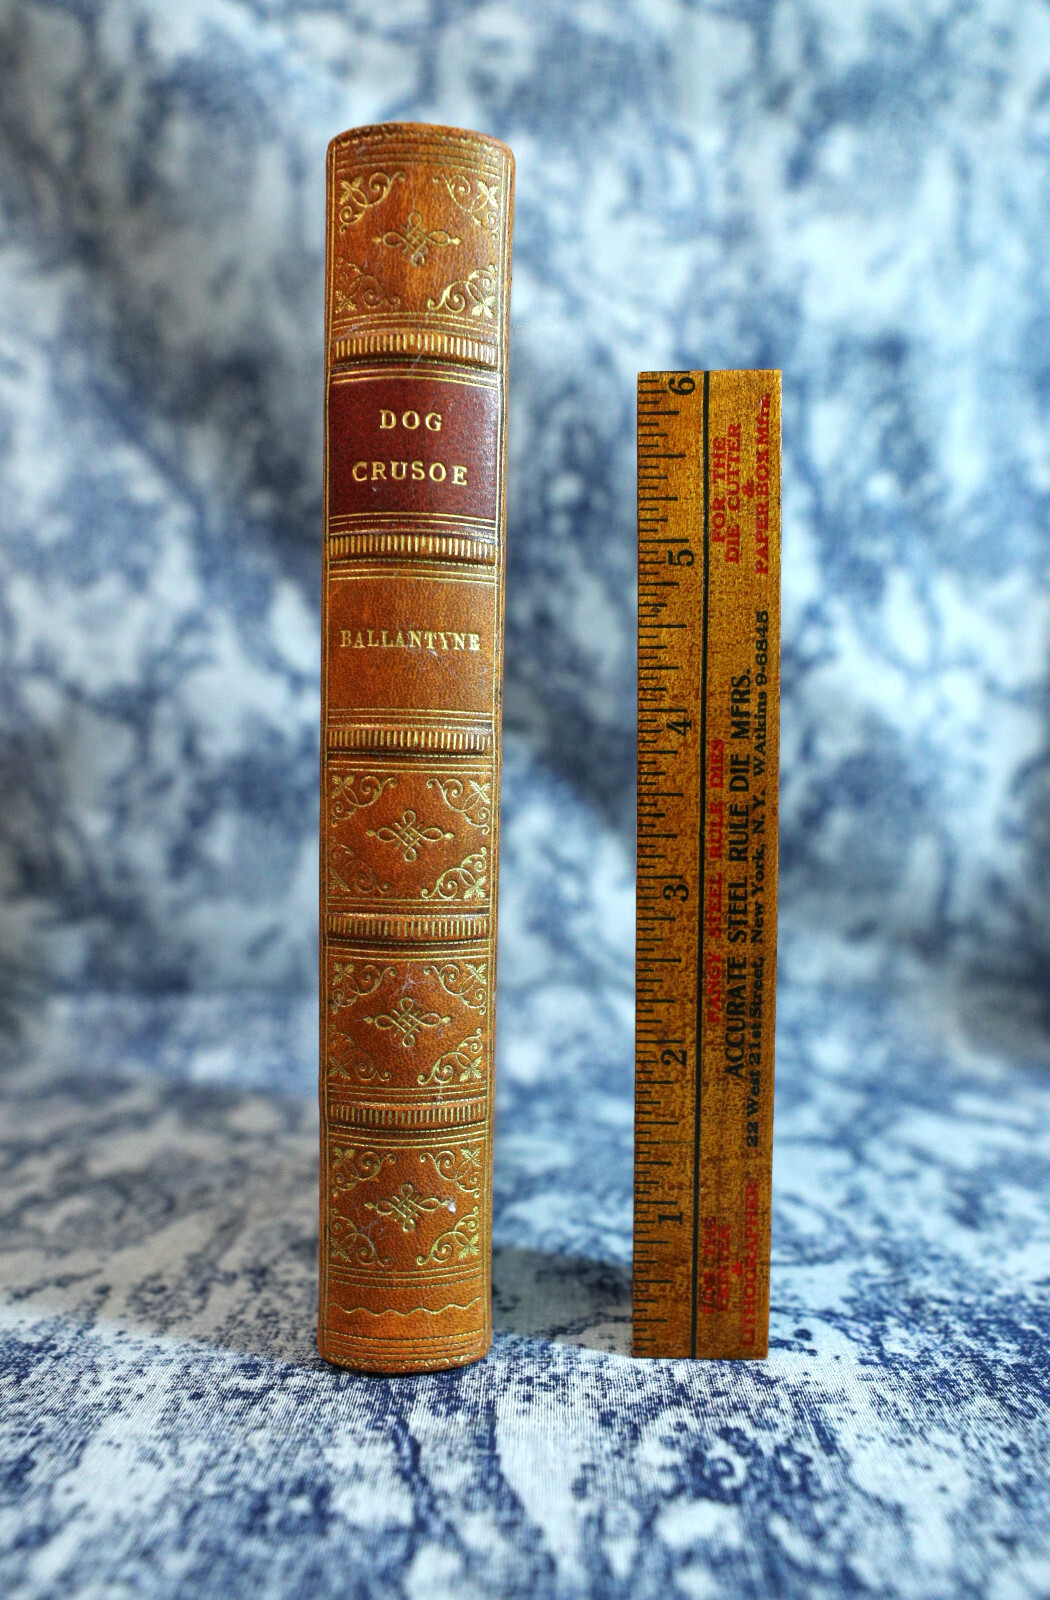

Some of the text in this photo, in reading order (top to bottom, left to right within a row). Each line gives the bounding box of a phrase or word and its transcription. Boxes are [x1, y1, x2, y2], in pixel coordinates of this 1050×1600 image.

[669, 377, 695, 396] 6
[379, 409, 443, 431] DOG
[352, 460, 468, 486] CRUSOE
[712, 437, 726, 543] FOR THE
[726, 423, 741, 564] DIE CUTTER
[741, 480, 754, 498] &
[755, 449, 769, 496] BOX
[668, 549, 694, 567] 5
[754, 501, 769, 574] PAPER
[340, 629, 482, 651] BALLANTYNE
[755, 610, 768, 686] 9-6845
[666, 718, 692, 737] 4
[707, 739, 723, 1022] FANCY STEEL RULE DIES
[724, 668, 750, 1079] ACCURATE STEEL RULE DIE MFRS.
[751, 843, 766, 897] York,
[662, 884, 689, 902] 3
[750, 900, 764, 944] New
[749, 956, 764, 1019] Street,
[660, 1048, 687, 1066] 2
[748, 1023, 761, 1065] 21st
[746, 1070, 760, 1117] West
[746, 1121, 759, 1148] 22
[658, 1212, 683, 1225] 1
[702, 1216, 716, 1315] FOR THE
[717, 1224, 730, 1312] PRINTER
[742, 1181, 759, 1348] LITHOGRAPHER
